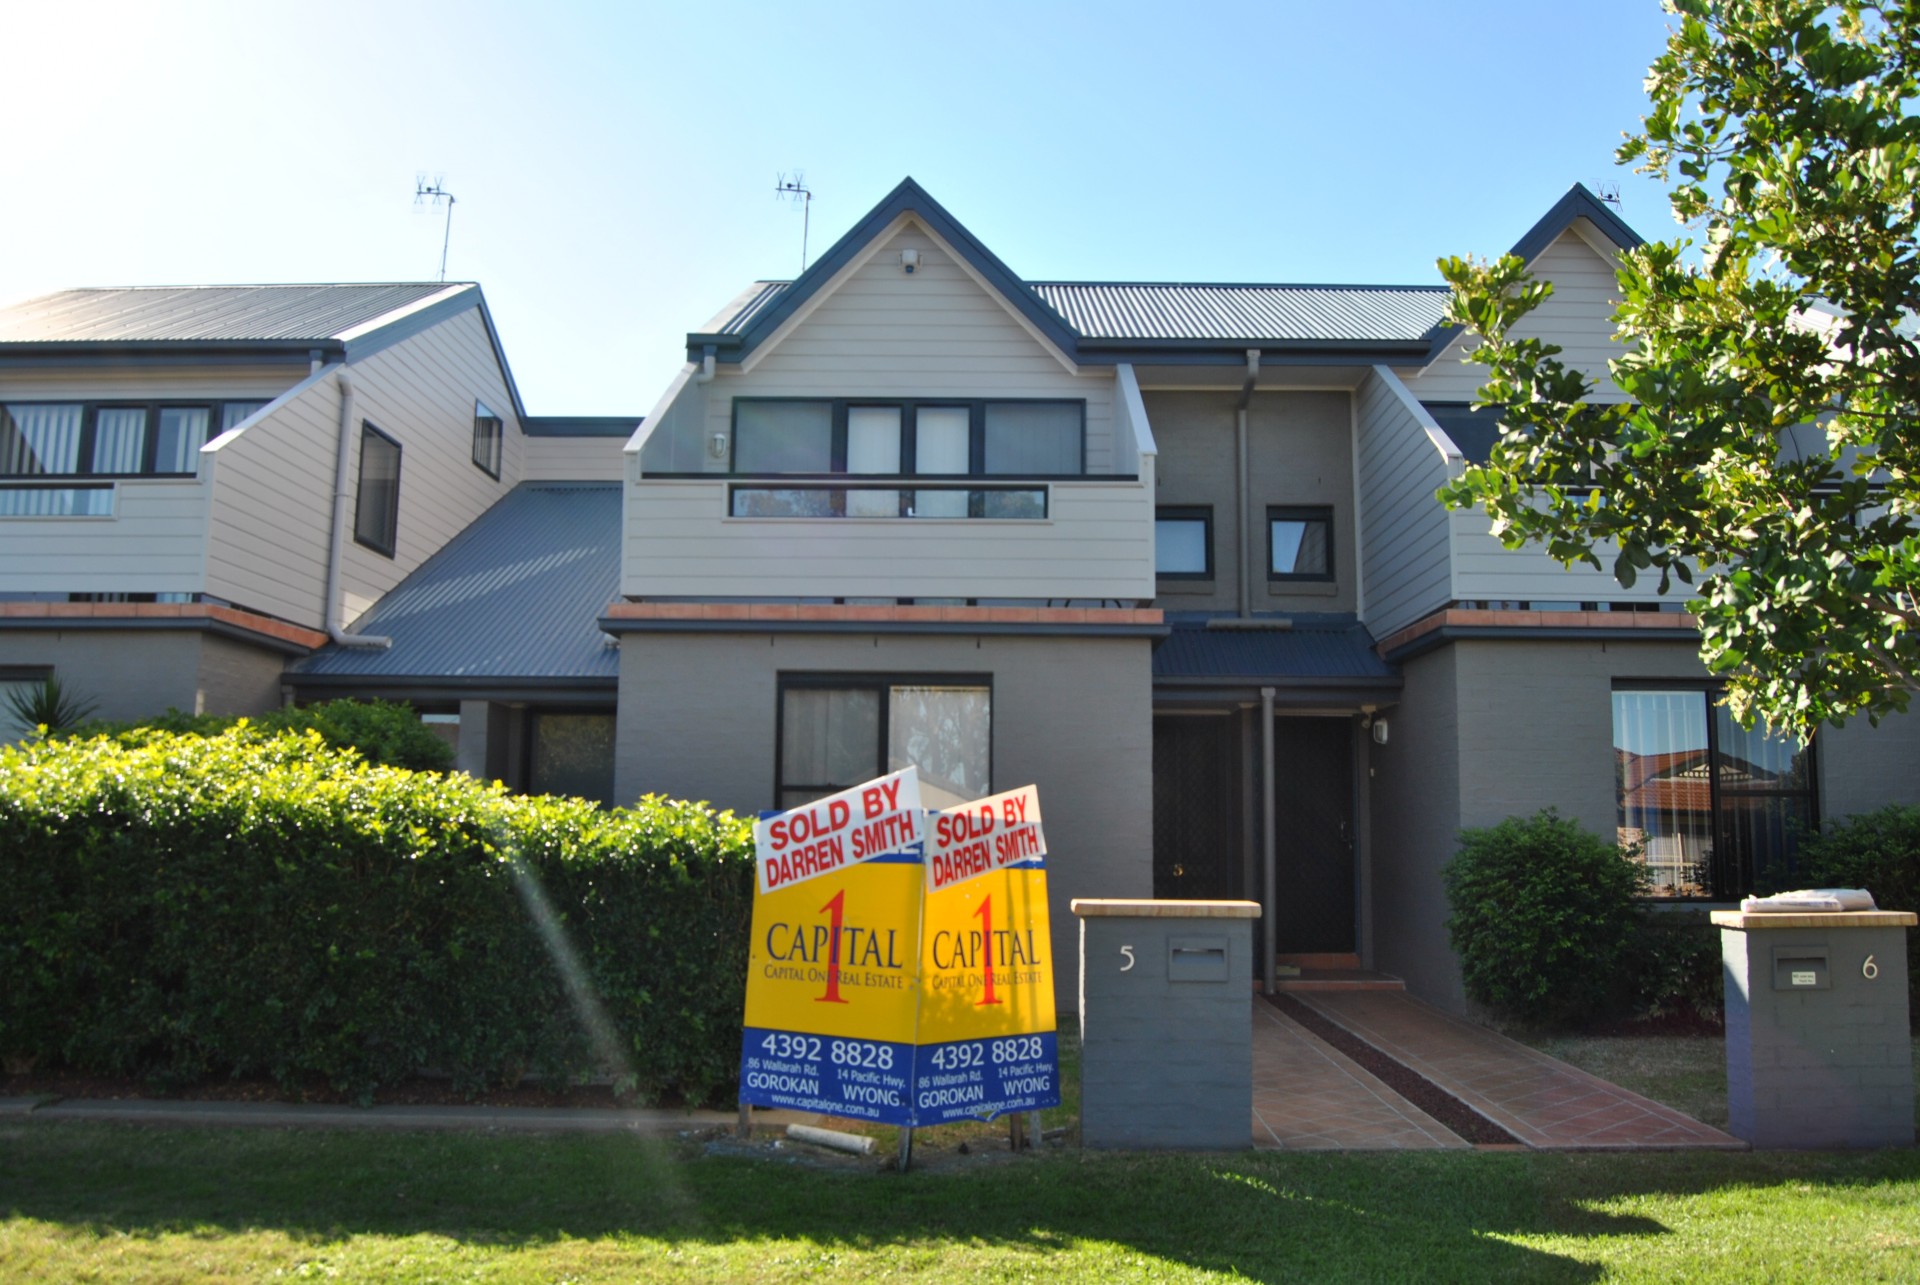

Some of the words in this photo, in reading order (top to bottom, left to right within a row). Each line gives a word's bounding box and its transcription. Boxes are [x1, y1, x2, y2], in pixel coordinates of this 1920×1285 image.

[769, 800, 850, 850] SOLD
[862, 778, 900, 820] BY
[936, 805, 994, 848] SOLD
[1003, 794, 1026, 828] BY
[765, 835, 845, 888] DARREN
[851, 810, 914, 859] SMITH
[932, 840, 992, 887] DARREN
[995, 825, 1039, 865] SMITH
[766, 922, 903, 969] CAPITAL
[932, 930, 1041, 970] CAPITAL
[1120, 945, 1135, 971] 5
[764, 964, 805, 982] CAPITAL
[836, 970, 861, 986] REAL
[865, 972, 904, 989] ESTATE
[1862, 954, 1878, 979] 6
[932, 974, 965, 990] CAPITAL
[991, 972, 1012, 986] REAL
[1013, 971, 1042, 985] ESTATE
[761, 1033, 822, 1062] 4392
[830, 1040, 893, 1070] 8828
[931, 1043, 985, 1071] 4392
[991, 1036, 1043, 1064] 8828
[748, 1057, 760, 1069] 86
[762, 1059, 801, 1074] Wallarah
[803, 1064, 820, 1077] Rd.
[837, 1068, 848, 1080] 14
[851, 1070, 881, 1085] Pacific
[883, 1074, 906, 1090] Hwy.
[918, 1076, 930, 1089] 86
[932, 1072, 968, 1087] Wallarah
[969, 1070, 983, 1081] Rd.
[998, 1067, 1008, 1079] 14
[1010, 1063, 1034, 1077] Pacific
[1036, 1062, 1054, 1074] Hwy.
[747, 1071, 819, 1095] GOROKAN
[842, 1083, 900, 1107] WYONG
[1003, 1075, 1050, 1097] WYONG
[771, 1093, 880, 1118] www.capitalone.com.au
[919, 1085, 984, 1109] GOROKAN
[942, 1097, 1036, 1119] www.capitalone.com.au
